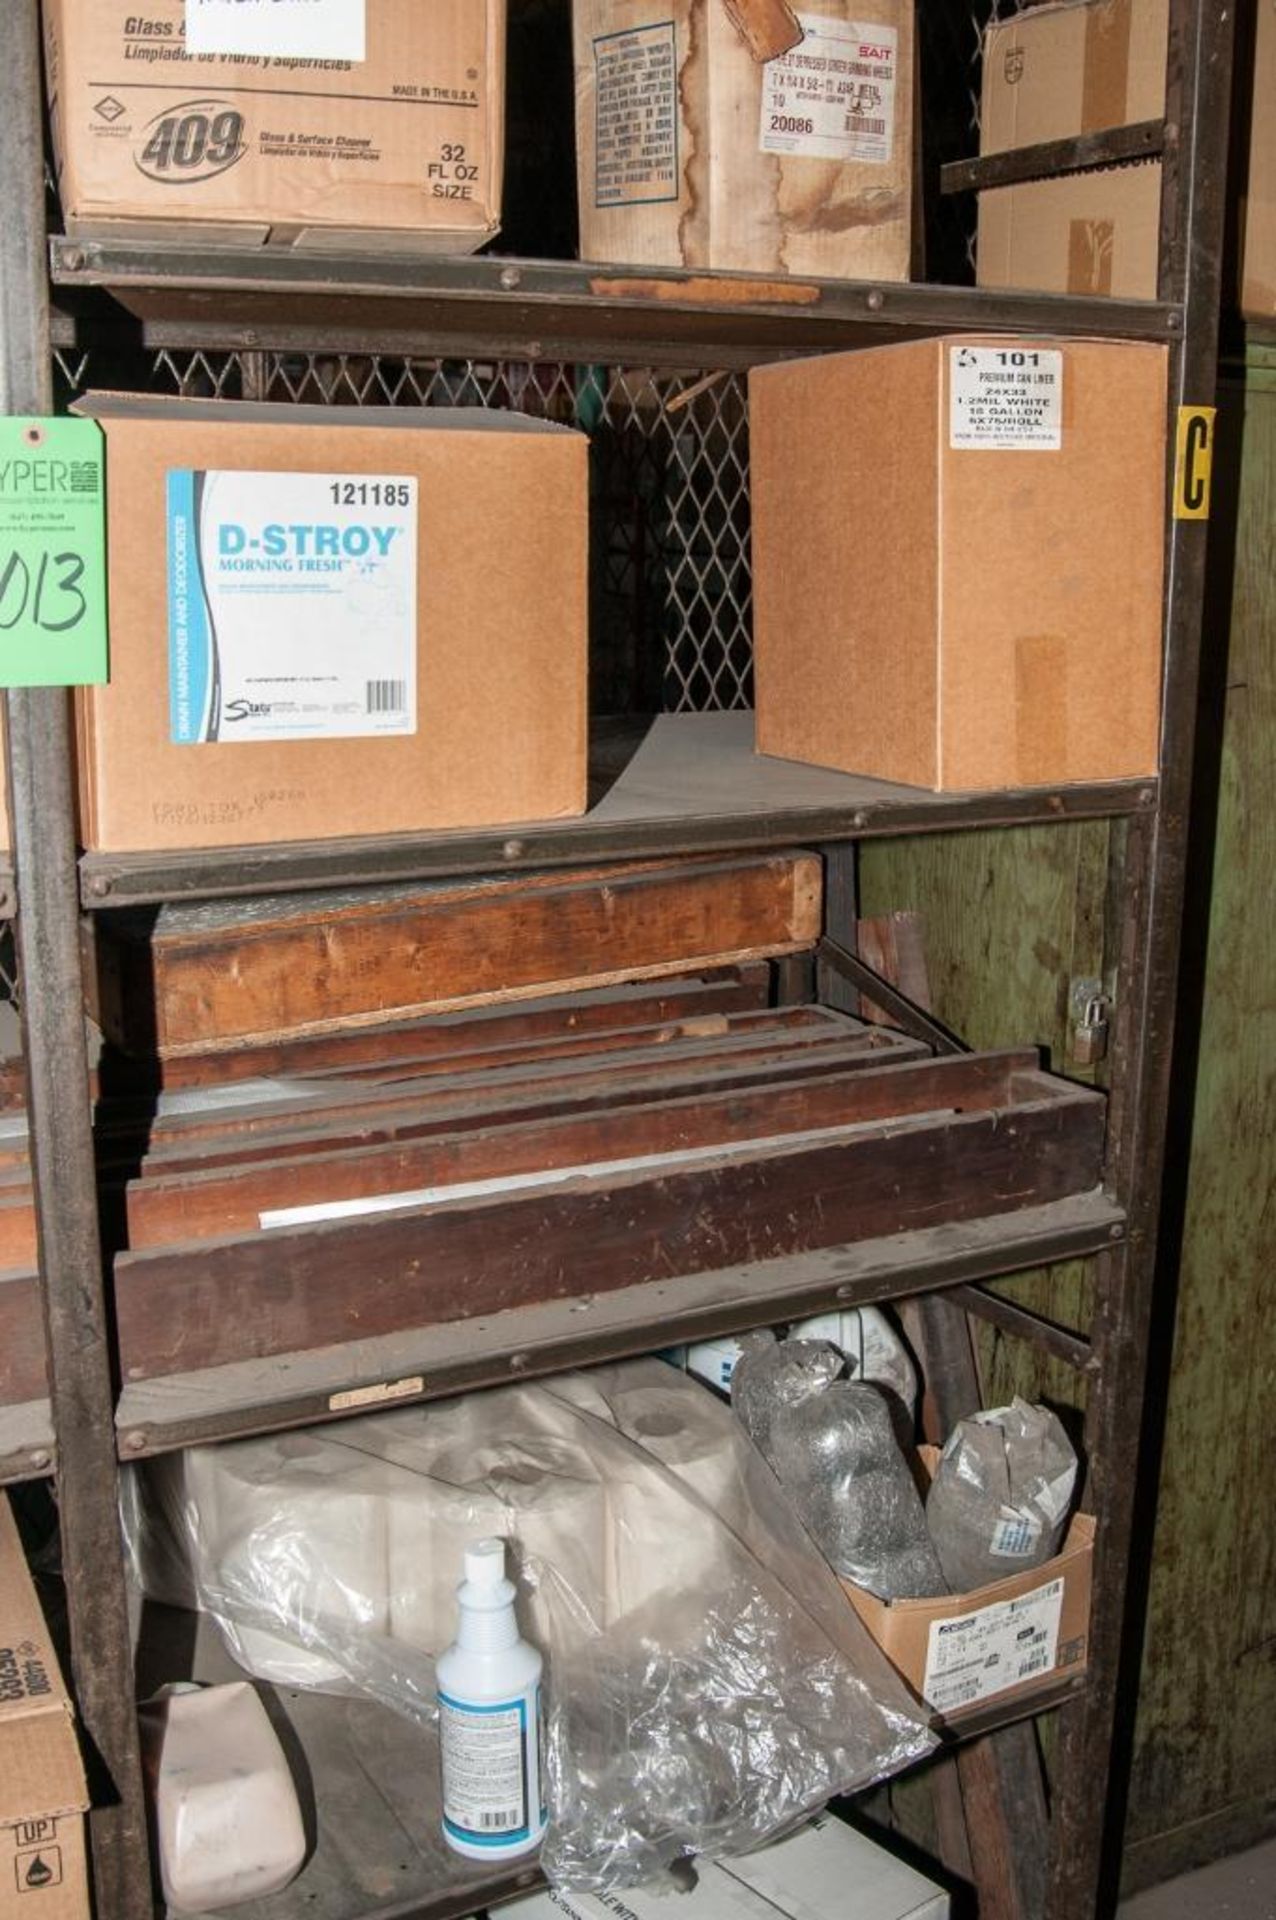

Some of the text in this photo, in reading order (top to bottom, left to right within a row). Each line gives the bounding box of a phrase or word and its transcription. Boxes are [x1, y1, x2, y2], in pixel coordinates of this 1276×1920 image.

[124, 17, 173, 36] Glass
[859, 46, 893, 60] SAIT
[392, 85, 418, 96] MADE
[770, 115, 813, 134] 20086
[142, 111, 245, 170] 409
[441, 144, 465, 162] 32
[428, 164, 478, 181] FL OZ
[432, 184, 473, 201] SIZE
[995, 352, 1039, 367] 101
[1006, 398, 1051, 407] WHITE
[989, 408, 1043, 417] GALLON
[1183, 415, 1205, 511] C
[330, 482, 409, 506] 121185
[218, 524, 397, 556] D-STROY
[218, 558, 293, 571] MORNING
[175, 598, 187, 625] AND
[175, 629, 189, 698] MAINTAINER
[177, 702, 190, 739] DRAIN
[24, 1821, 48, 1841] UP
